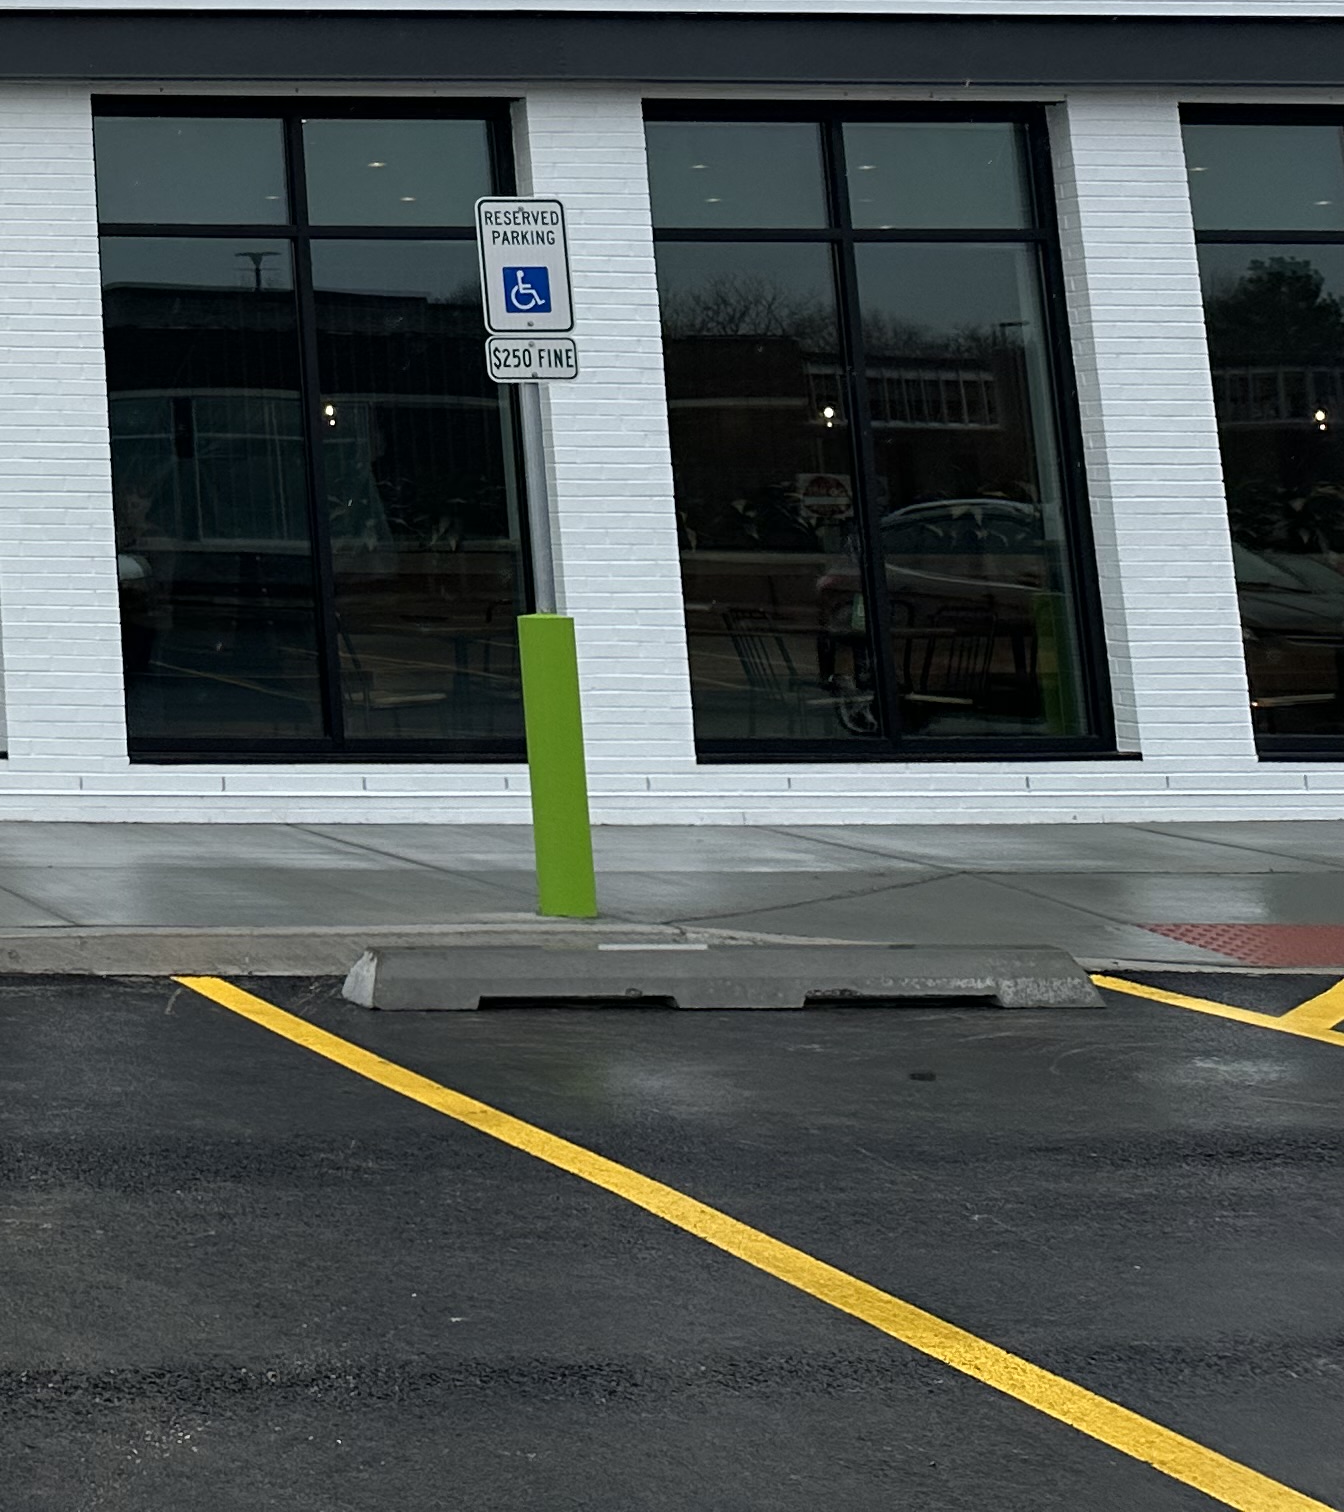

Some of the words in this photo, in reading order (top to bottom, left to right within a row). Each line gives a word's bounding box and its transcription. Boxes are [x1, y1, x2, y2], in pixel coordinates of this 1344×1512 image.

[484, 210, 559, 226] RESERVED
[491, 230, 556, 245] PARKING
[493, 347, 532, 370] $250
[538, 348, 574, 368] FINE
